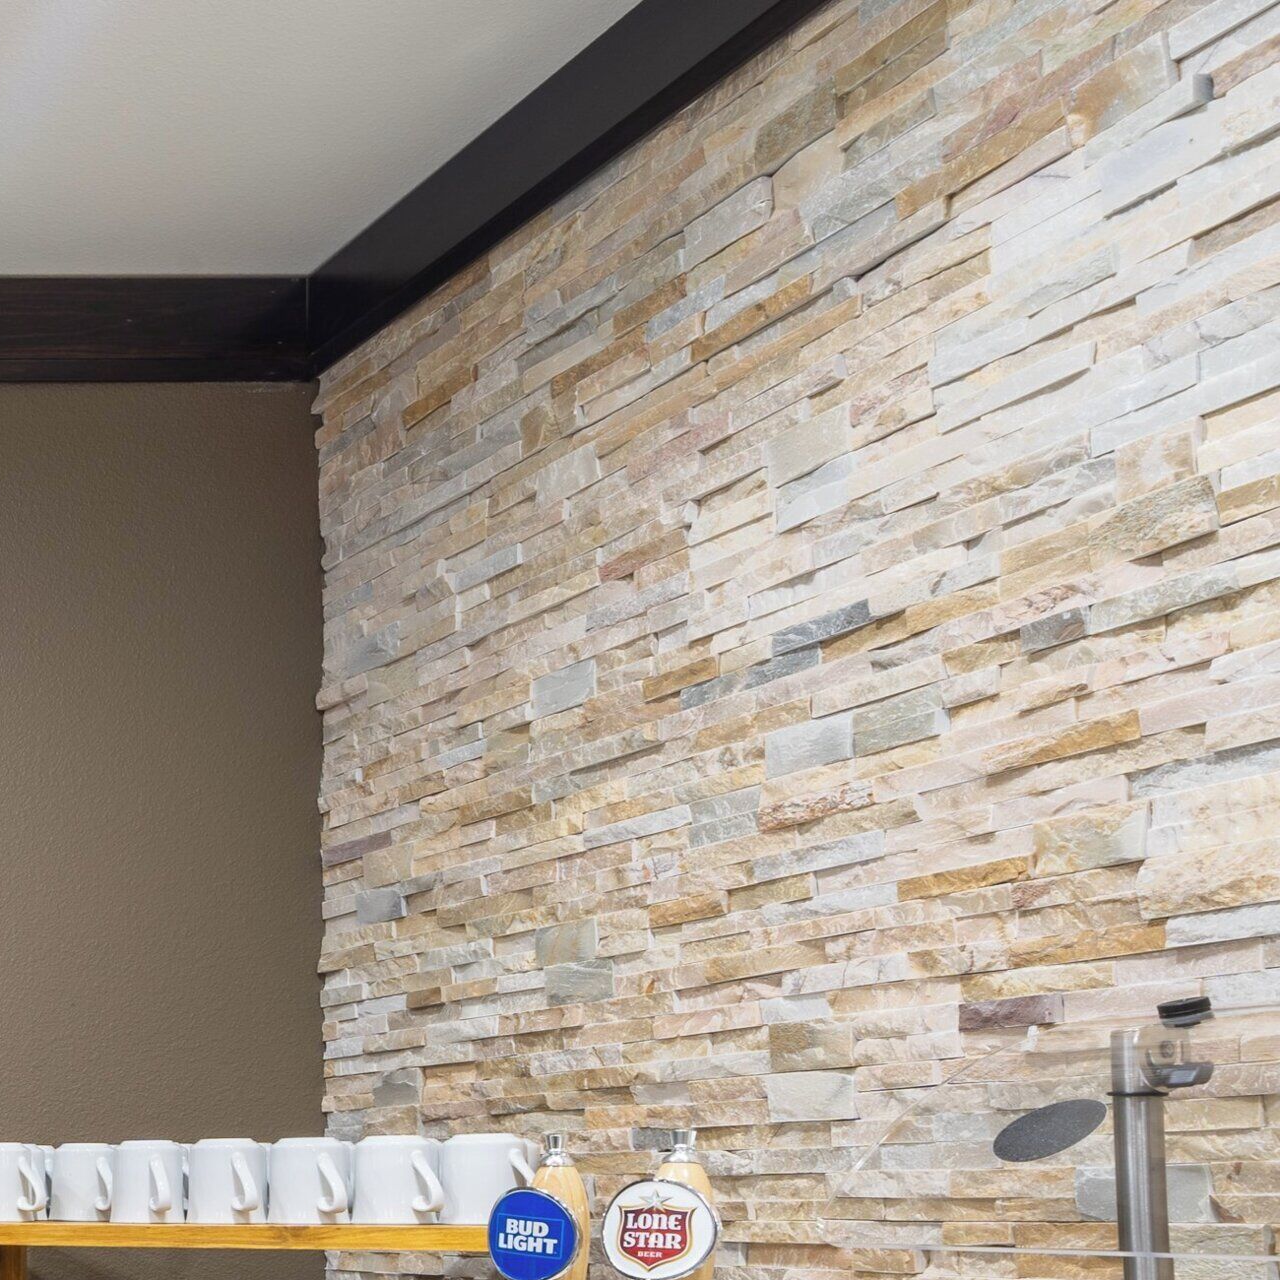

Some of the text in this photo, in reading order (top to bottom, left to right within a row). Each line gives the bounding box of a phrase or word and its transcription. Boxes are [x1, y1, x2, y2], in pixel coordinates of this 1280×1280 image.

[505, 1218, 550, 1236] BUD
[626, 1213, 682, 1230] LONE
[498, 1232, 557, 1255] LIGHT
[623, 1232, 683, 1250] STAR
[637, 1250, 663, 1258] BEER
